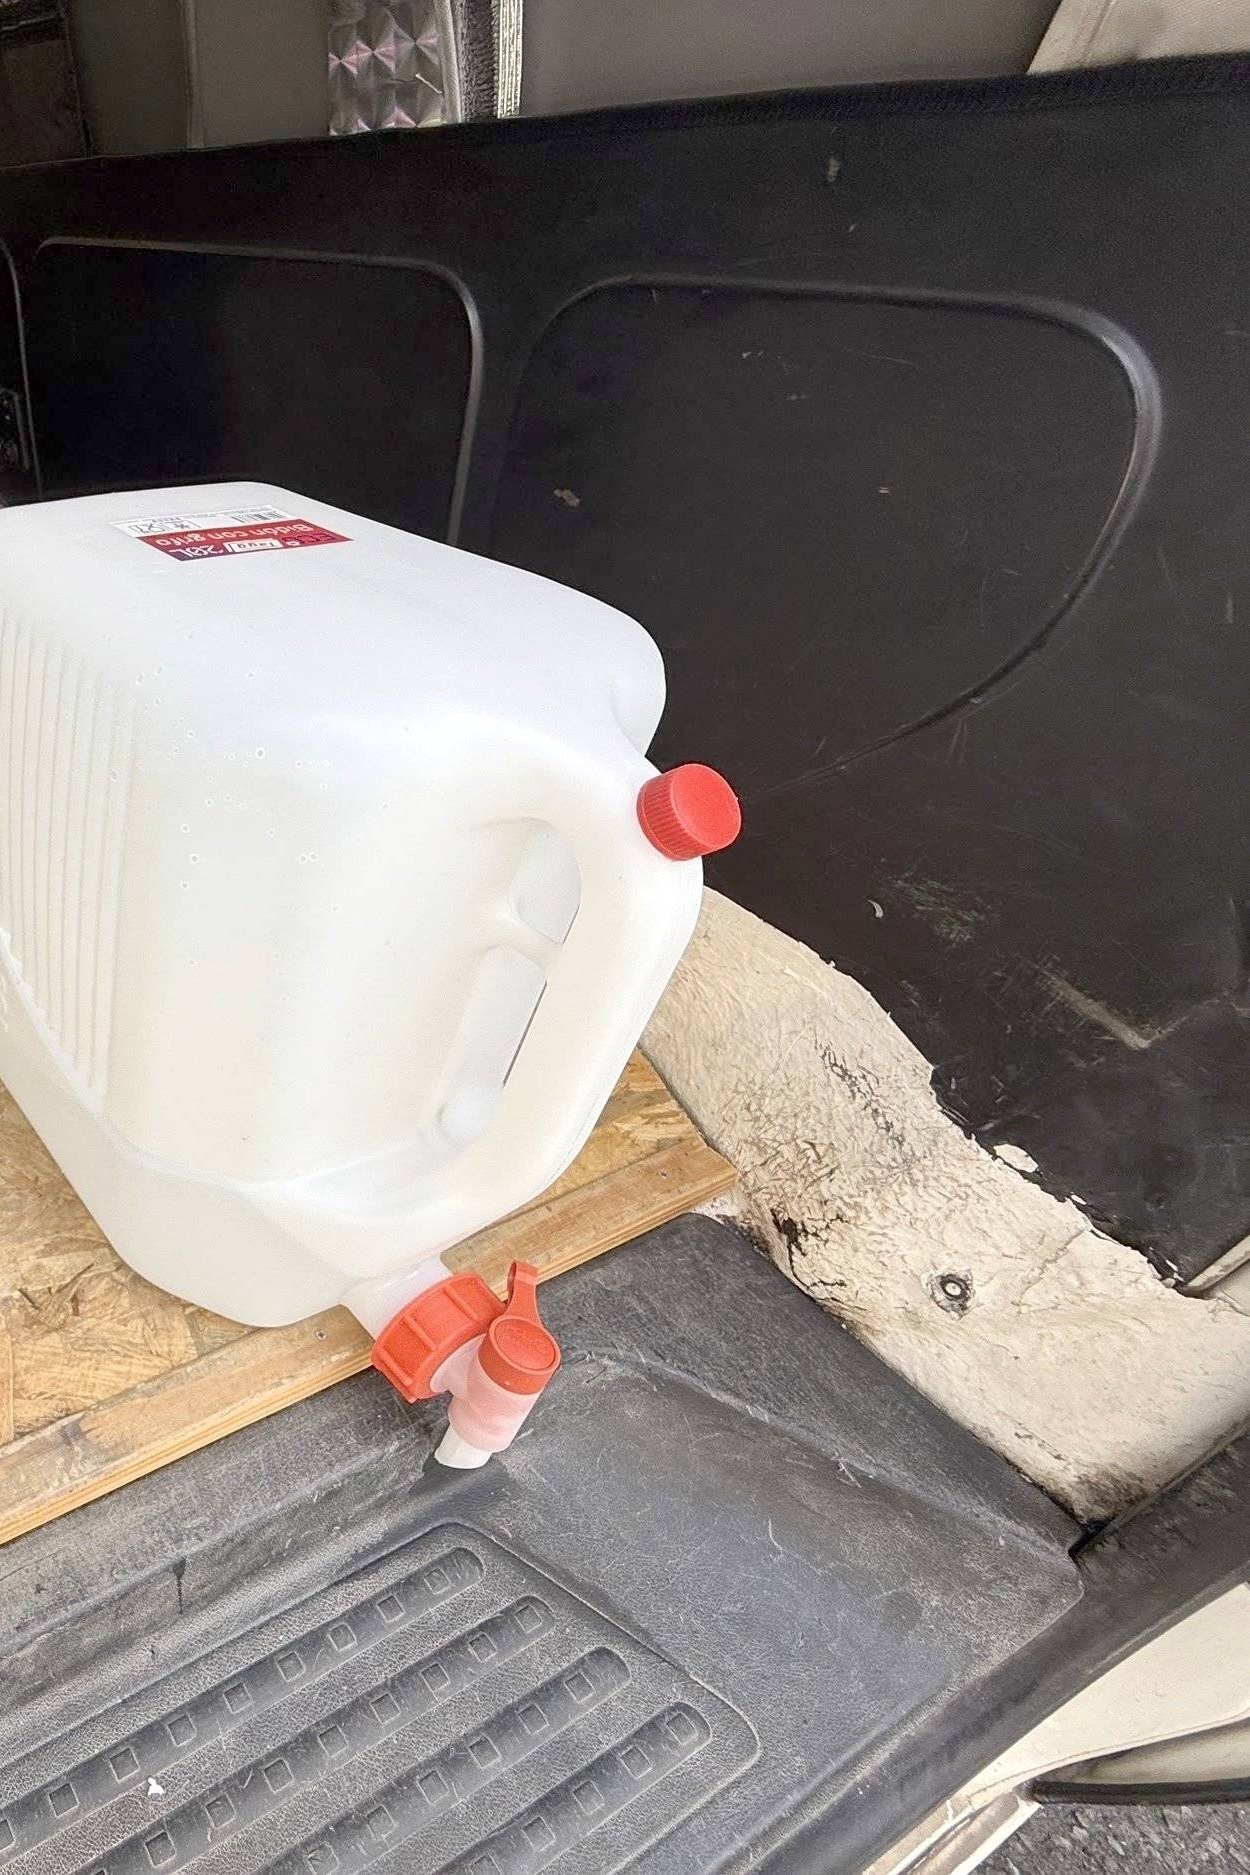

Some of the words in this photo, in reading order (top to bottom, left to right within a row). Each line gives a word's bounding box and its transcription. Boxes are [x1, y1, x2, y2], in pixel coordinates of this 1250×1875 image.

[207, 529, 248, 539] con
[249, 523, 314, 535] Bidón
[155, 533, 206, 546] grifo
